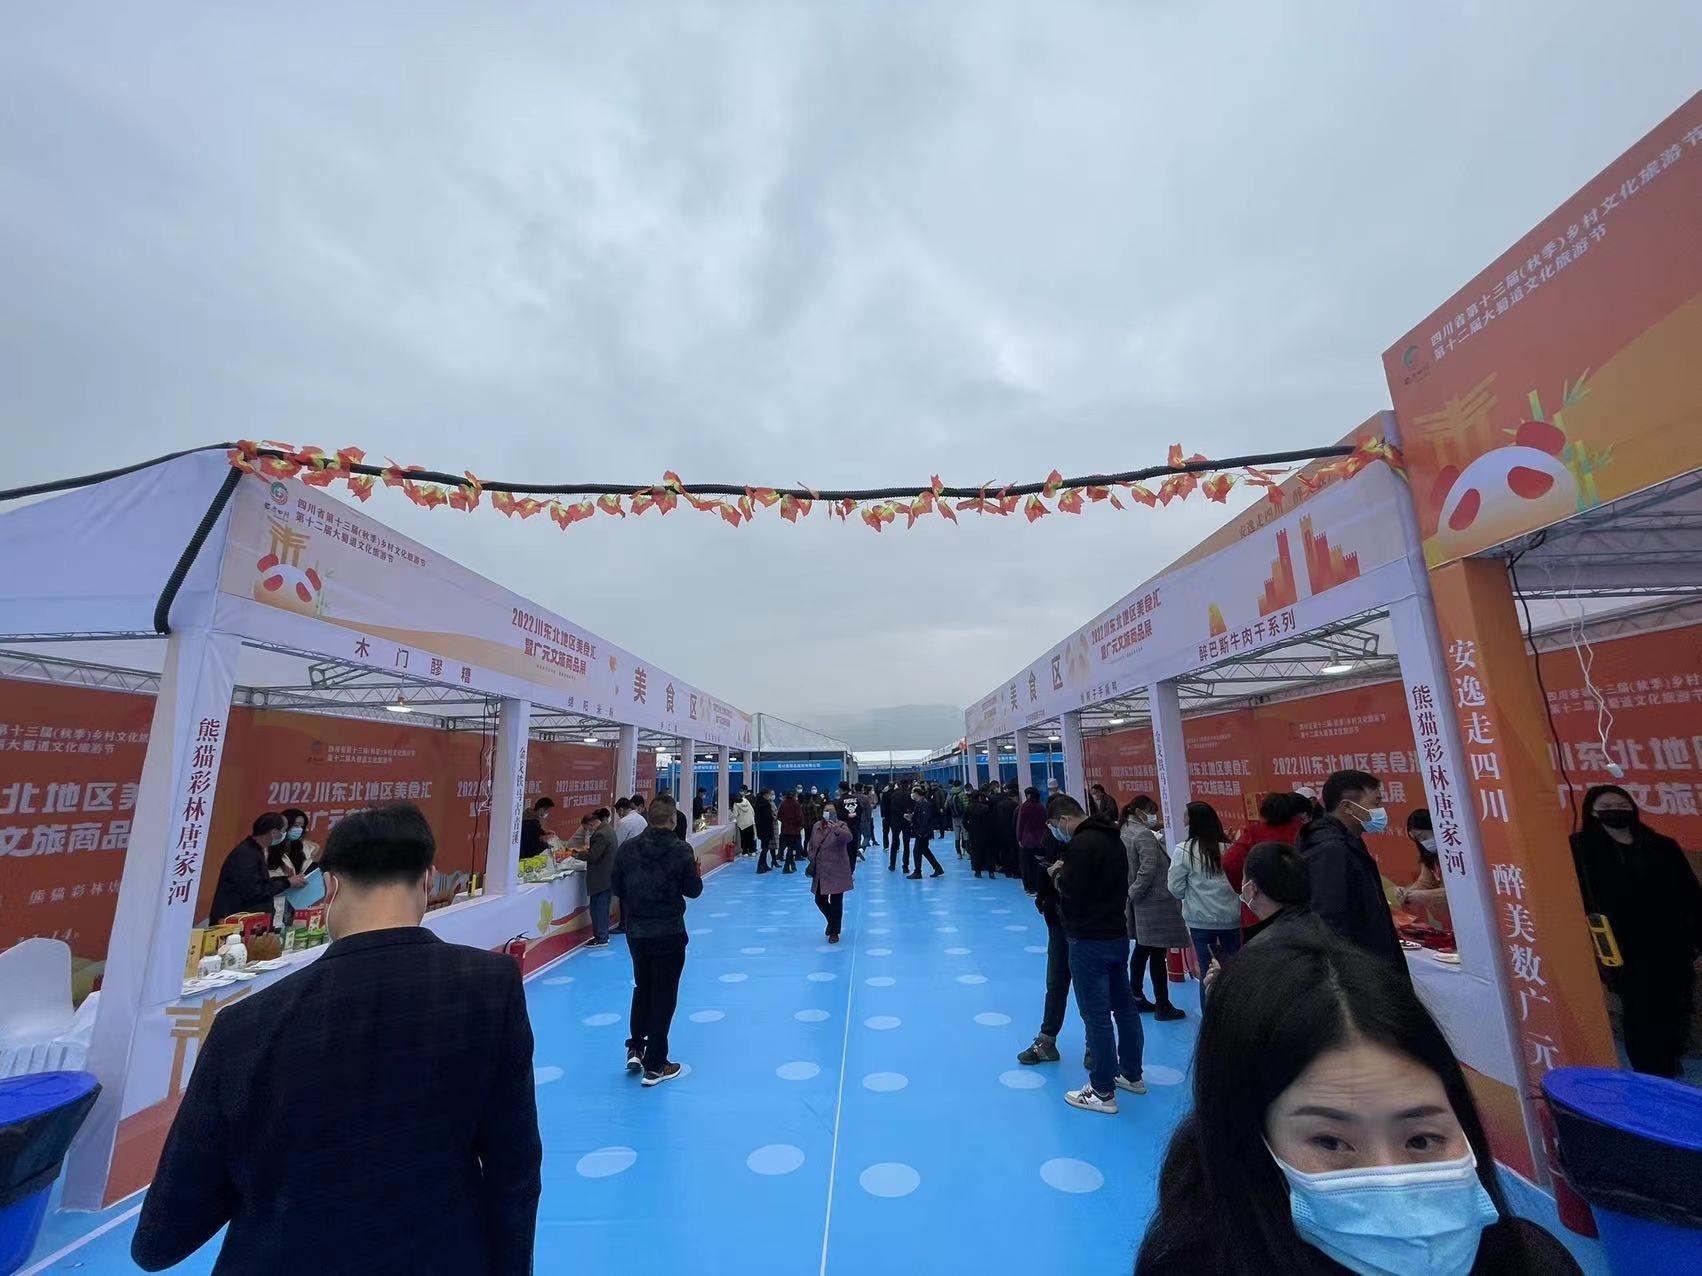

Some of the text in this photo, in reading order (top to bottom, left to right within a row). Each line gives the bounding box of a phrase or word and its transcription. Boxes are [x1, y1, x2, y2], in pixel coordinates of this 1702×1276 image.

[1434, 223, 1607, 361] 第十二届大蜀道文化旅游节
[295, 511, 394, 564] 第十二届大蜀道文化旅游节
[511, 607, 597, 660] 2022川东北地区美食汇
[1091, 587, 1162, 646] 2022川东北地区美食汇
[1100, 618, 1153, 661] 暨广元文旅商品展
[524, 637, 587, 676] 暨广元文旅商品展
[1009, 654, 1064, 712] 美食区
[633, 666, 698, 721] 美食区
[1448, 639, 1509, 823] 安逸走四川
[267, 781, 433, 805] 2022川东北地区美食汇
[1412, 685, 1467, 877] 熊猫彩林唐家河
[168, 718, 220, 906] 熊猫彩林唐家河
[1491, 863, 1560, 1070] 醉美数广元
